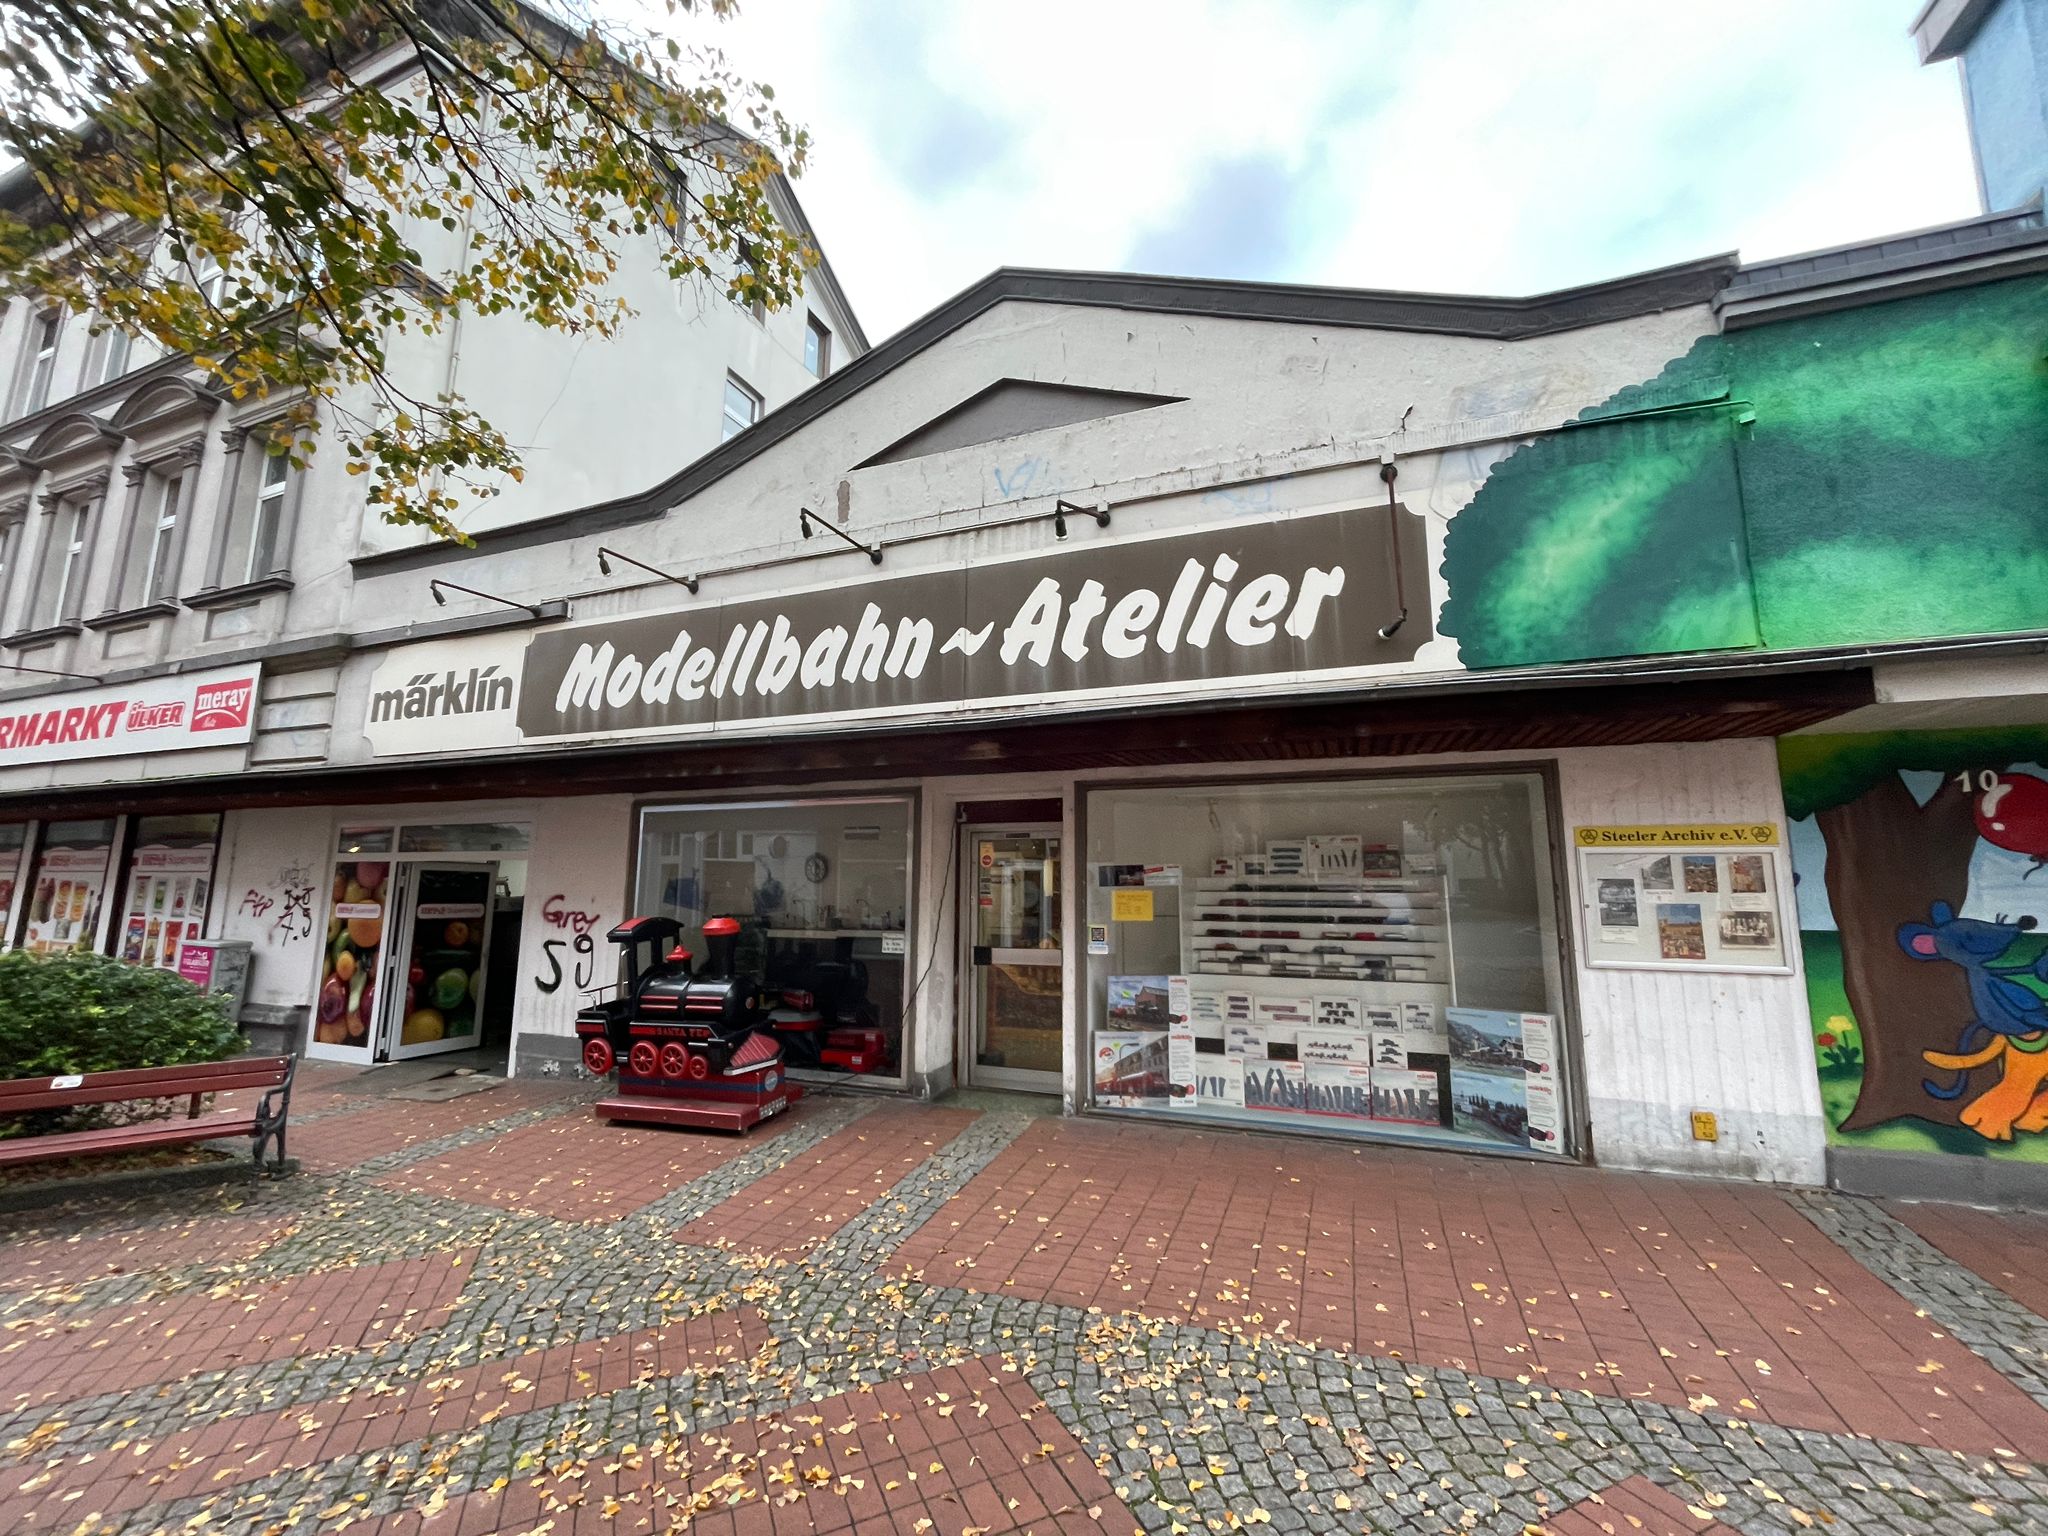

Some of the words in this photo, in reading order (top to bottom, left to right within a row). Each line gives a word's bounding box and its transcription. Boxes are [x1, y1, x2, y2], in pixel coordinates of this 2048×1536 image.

[196, 687, 248, 712] meray
[0, 701, 128, 750] RMARKT
[127, 702, 185, 732] ÜLKER
[1954, 769, 1999, 793] 10
[1601, 831, 1657, 842] Steeler
[1661, 829, 1715, 841] Archiv
[1719, 829, 1748, 841] e.V.
